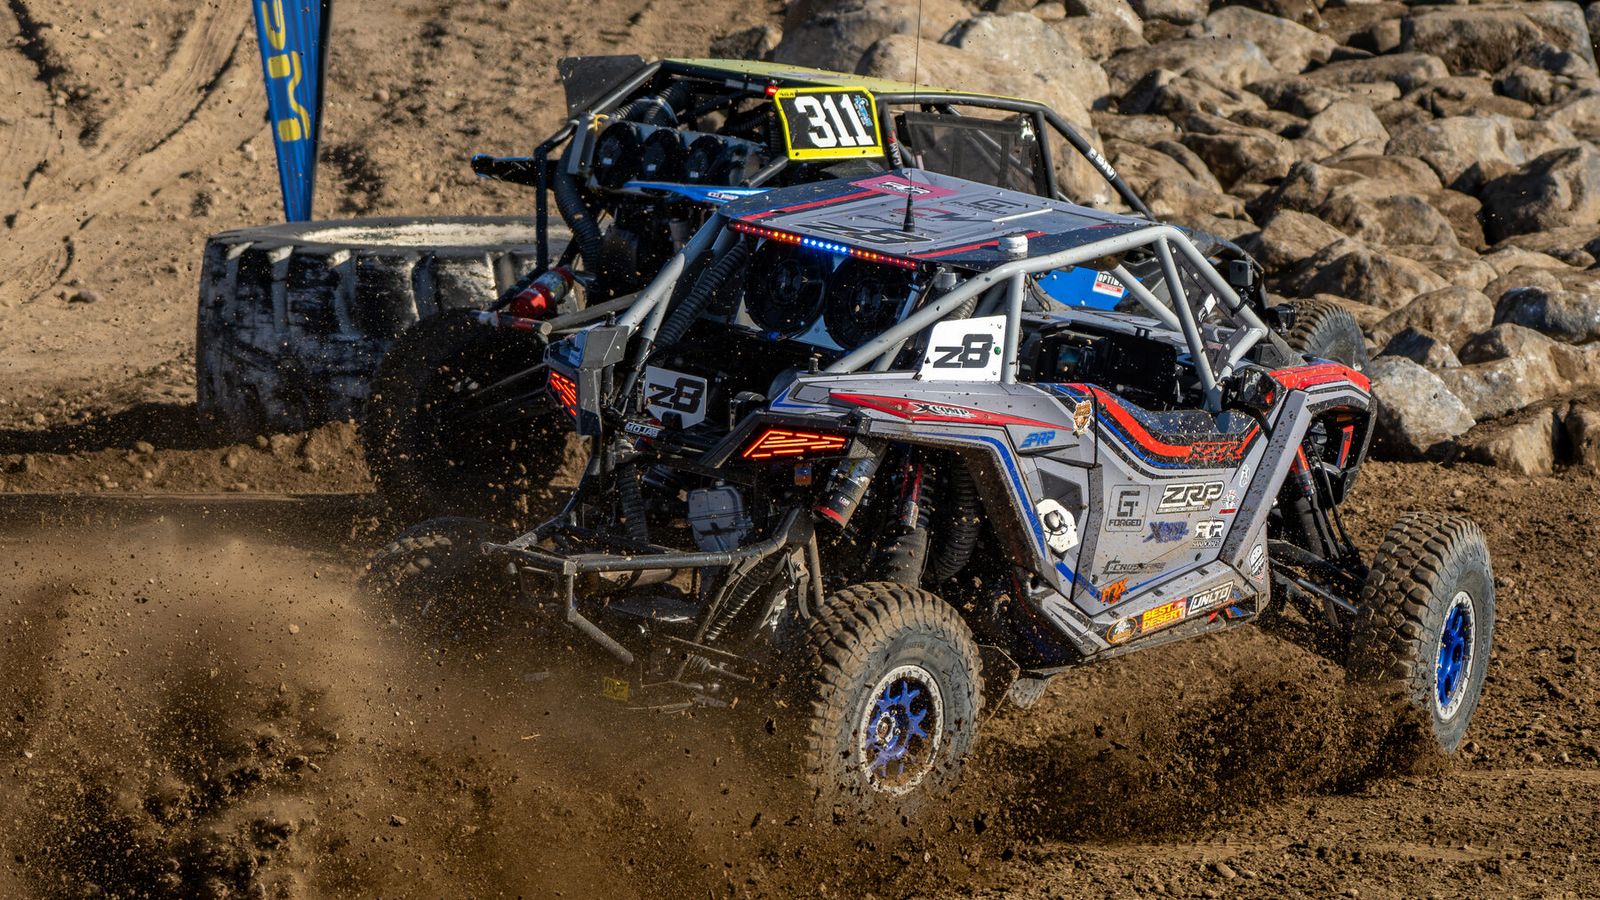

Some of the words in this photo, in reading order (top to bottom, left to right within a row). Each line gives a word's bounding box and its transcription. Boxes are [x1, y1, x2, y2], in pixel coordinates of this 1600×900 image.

[795, 93, 875, 148] 311
[1161, 483, 1224, 507] ZRP
[1108, 519, 1142, 527] FORGED
[1142, 607, 1184, 629] DESERT
[1143, 603, 1173, 621] BEST
